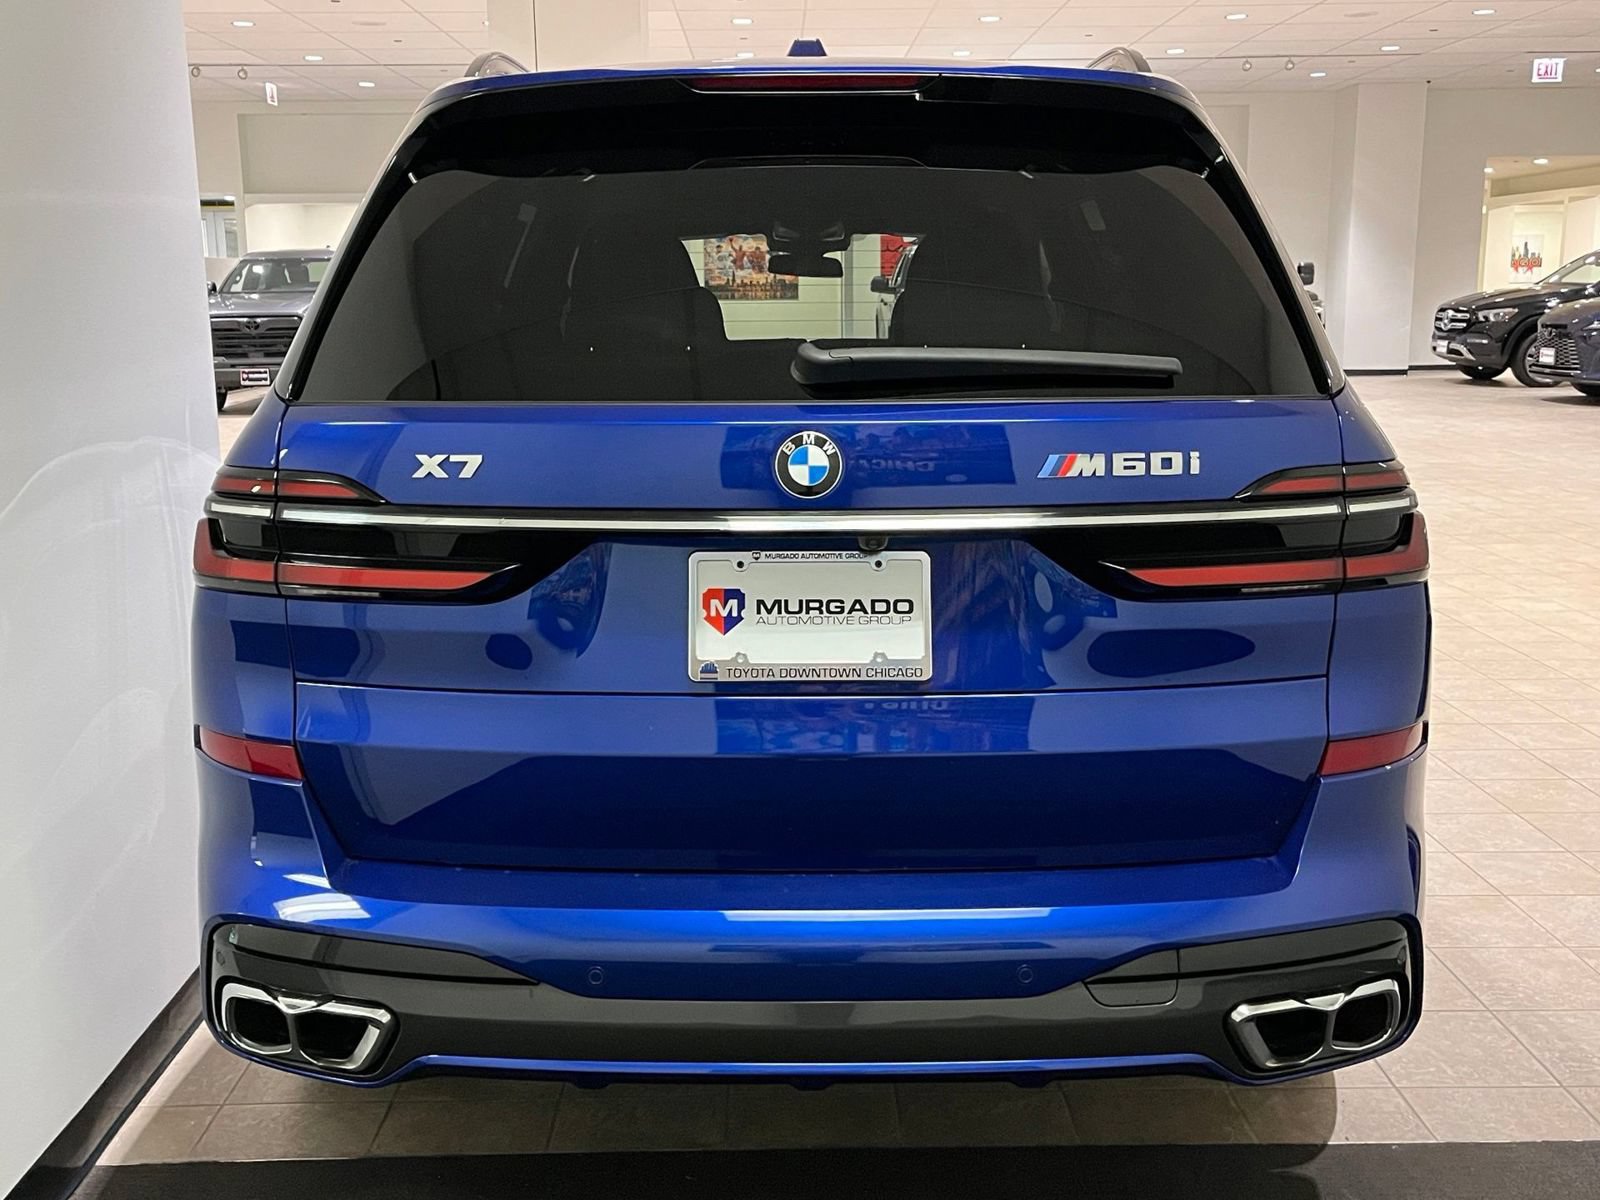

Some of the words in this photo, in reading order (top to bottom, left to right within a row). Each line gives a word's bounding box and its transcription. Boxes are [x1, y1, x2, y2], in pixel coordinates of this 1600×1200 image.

[1537, 62, 1559, 76] EXIT
[782, 433, 836, 456] BMW
[412, 454, 483, 478] X7
[710, 599, 738, 617] M
[756, 599, 914, 615] MURGADO
[756, 616, 855, 625] AUTOMOTIVE
[858, 616, 912, 625] GROUP
[726, 668, 775, 678] TOYOTA
[779, 668, 862, 678] DOWNTOWN
[865, 667, 923, 678] CHICAGO
